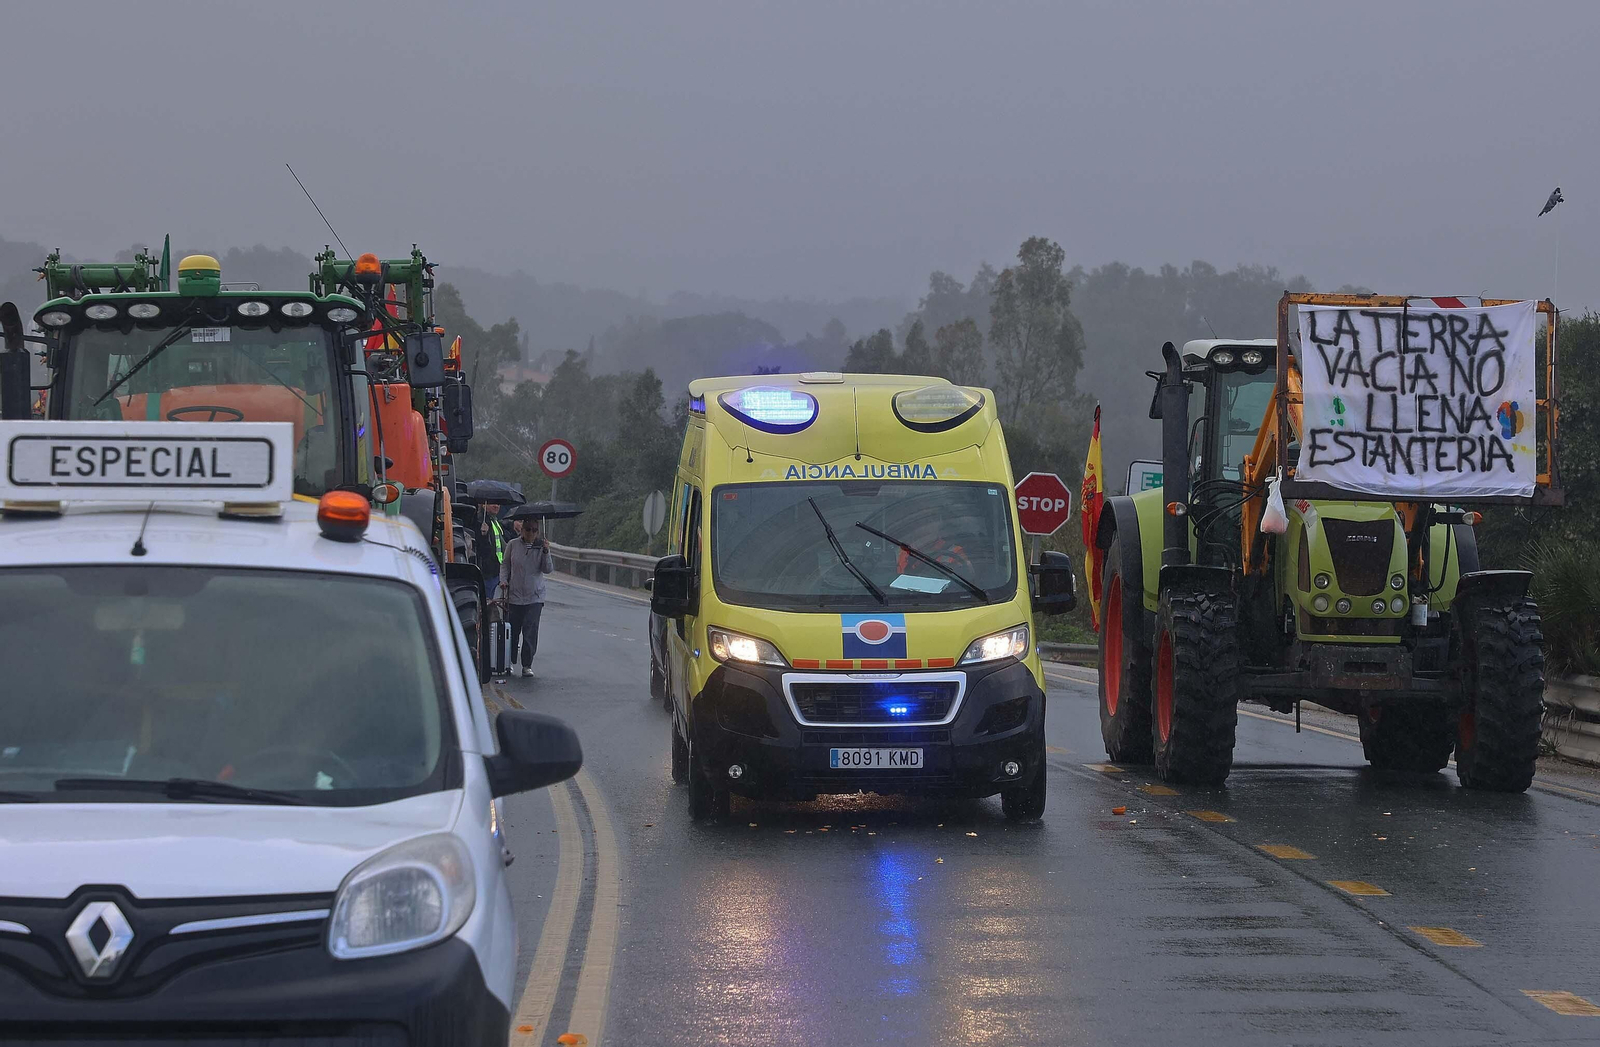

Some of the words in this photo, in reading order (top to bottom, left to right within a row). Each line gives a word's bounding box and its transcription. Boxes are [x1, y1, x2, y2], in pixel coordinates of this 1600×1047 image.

[1304, 310, 1360, 350] LA
[1360, 311, 1509, 357] TIERRA
[1316, 344, 1438, 395] VACIA
[1449, 350, 1505, 397] NO
[1366, 393, 1494, 434] LLENA
[51, 446, 231, 478] ESPECIAL
[546, 451, 569, 465] 80
[1309, 428, 1515, 475] ESTANTERIA
[1142, 474, 1163, 490] E-
[1017, 496, 1066, 513] STOP
[842, 751, 880, 766] 8091
[889, 751, 919, 766] KMD
